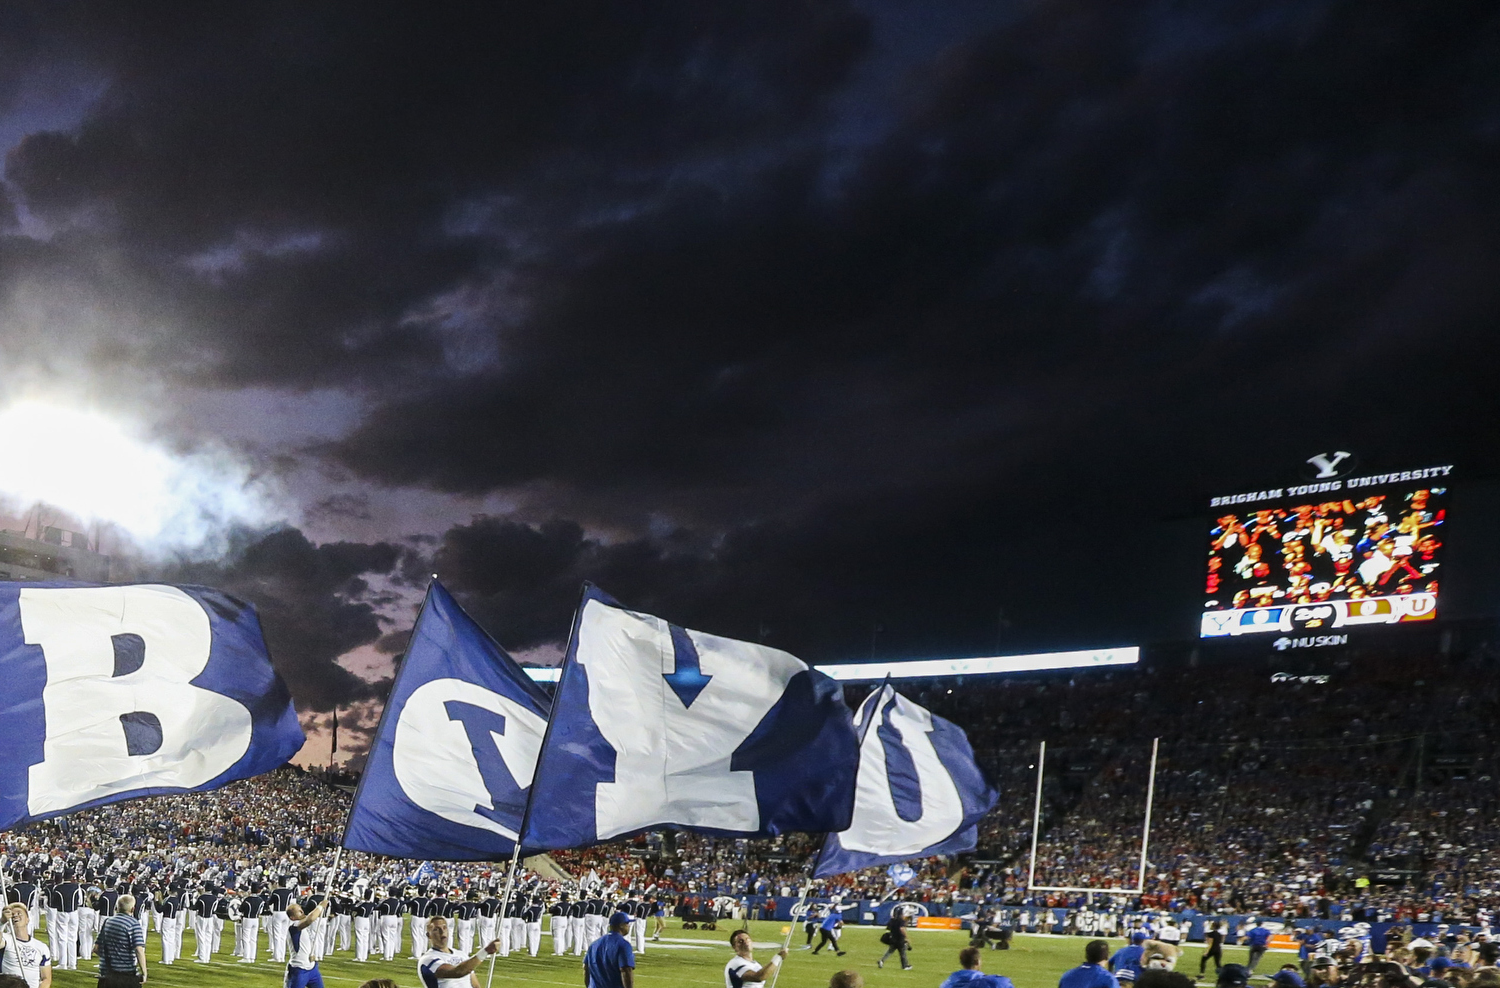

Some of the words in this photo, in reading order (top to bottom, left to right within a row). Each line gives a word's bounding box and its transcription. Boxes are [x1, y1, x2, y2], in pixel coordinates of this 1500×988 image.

[1210, 488, 1283, 508] BRIGHAM
[1287, 480, 1343, 497] YOUNG
[1347, 464, 1454, 489] UNIVERSITY
[1305, 451, 1351, 479] Y
[19, 584, 253, 817] B
